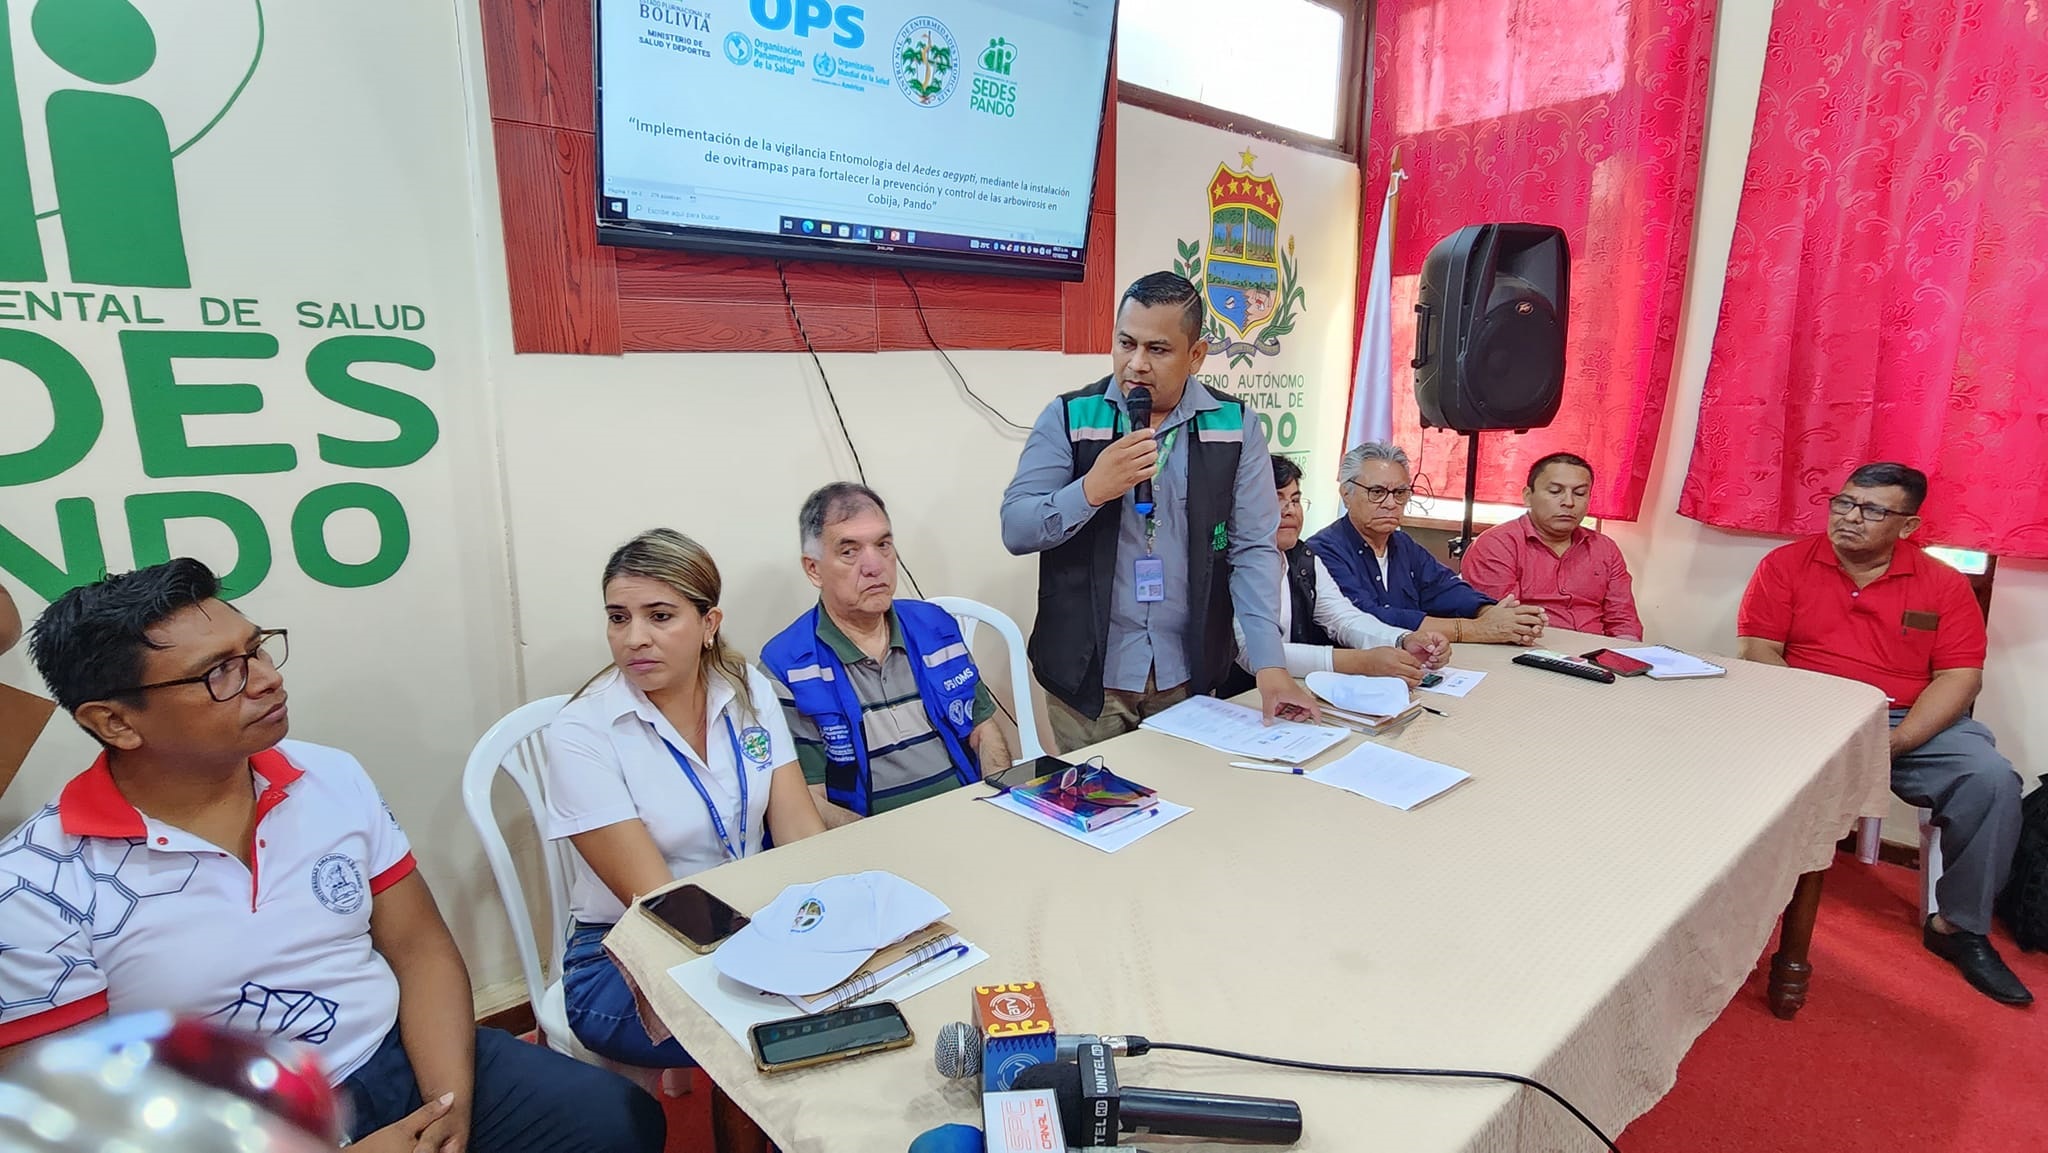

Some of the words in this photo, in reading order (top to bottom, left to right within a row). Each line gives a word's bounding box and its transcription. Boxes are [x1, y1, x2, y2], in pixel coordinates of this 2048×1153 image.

[640, 4, 710, 33] BOLIVIA
[639, 36, 664, 48] SALUD
[672, 43, 711, 57] DEPORTES
[647, 29, 692, 45] MINISTERIO
[693, 40, 703, 48] DE
[754, 38, 803, 57] Organización
[753, 60, 763, 69] de
[765, 60, 772, 71] la
[774, 62, 795, 75] Salud
[754, 48, 805, 68] Panamericana
[971, 77, 1016, 103] SEDES
[969, 95, 1015, 118] PANDO
[744, 136, 758, 149] de
[762, 138, 772, 151] la
[775, 142, 827, 160] vigilancia
[895, 160, 910, 173] del
[912, 164, 941, 177] Aedes
[942, 171, 978, 185] aegypti,
[980, 176, 1020, 190] mediante
[1020, 180, 1028, 191] la
[1029, 182, 1071, 197] instalación
[704, 150, 720, 164] de
[723, 154, 789, 174] ovitrampas
[792, 165, 816, 177] para
[819, 166, 870, 185] fortalecer
[871, 174, 881, 187] la
[883, 178, 935, 195] prevención
[937, 186, 943, 197] y
[944, 187, 976, 200] control
[977, 191, 988, 202] de
[990, 192, 1001, 203] las
[1003, 195, 1046, 210] arbovirosis
[1047, 203, 1058, 211] en
[867, 193, 901, 209] Cobija,
[200, 297, 261, 327] DE
[296, 301, 426, 331] SALUD
[1238, 371, 1305, 389] AUTÓNOMO
[1288, 392, 1304, 408] DE
[1091, 1044, 1104, 1057] HD
[1094, 1058, 1109, 1094] UNITEL
[1034, 1098, 1044, 1107] 15
[1095, 1099, 1109, 1117] HD
[1038, 1112, 1053, 1150] CANAL
